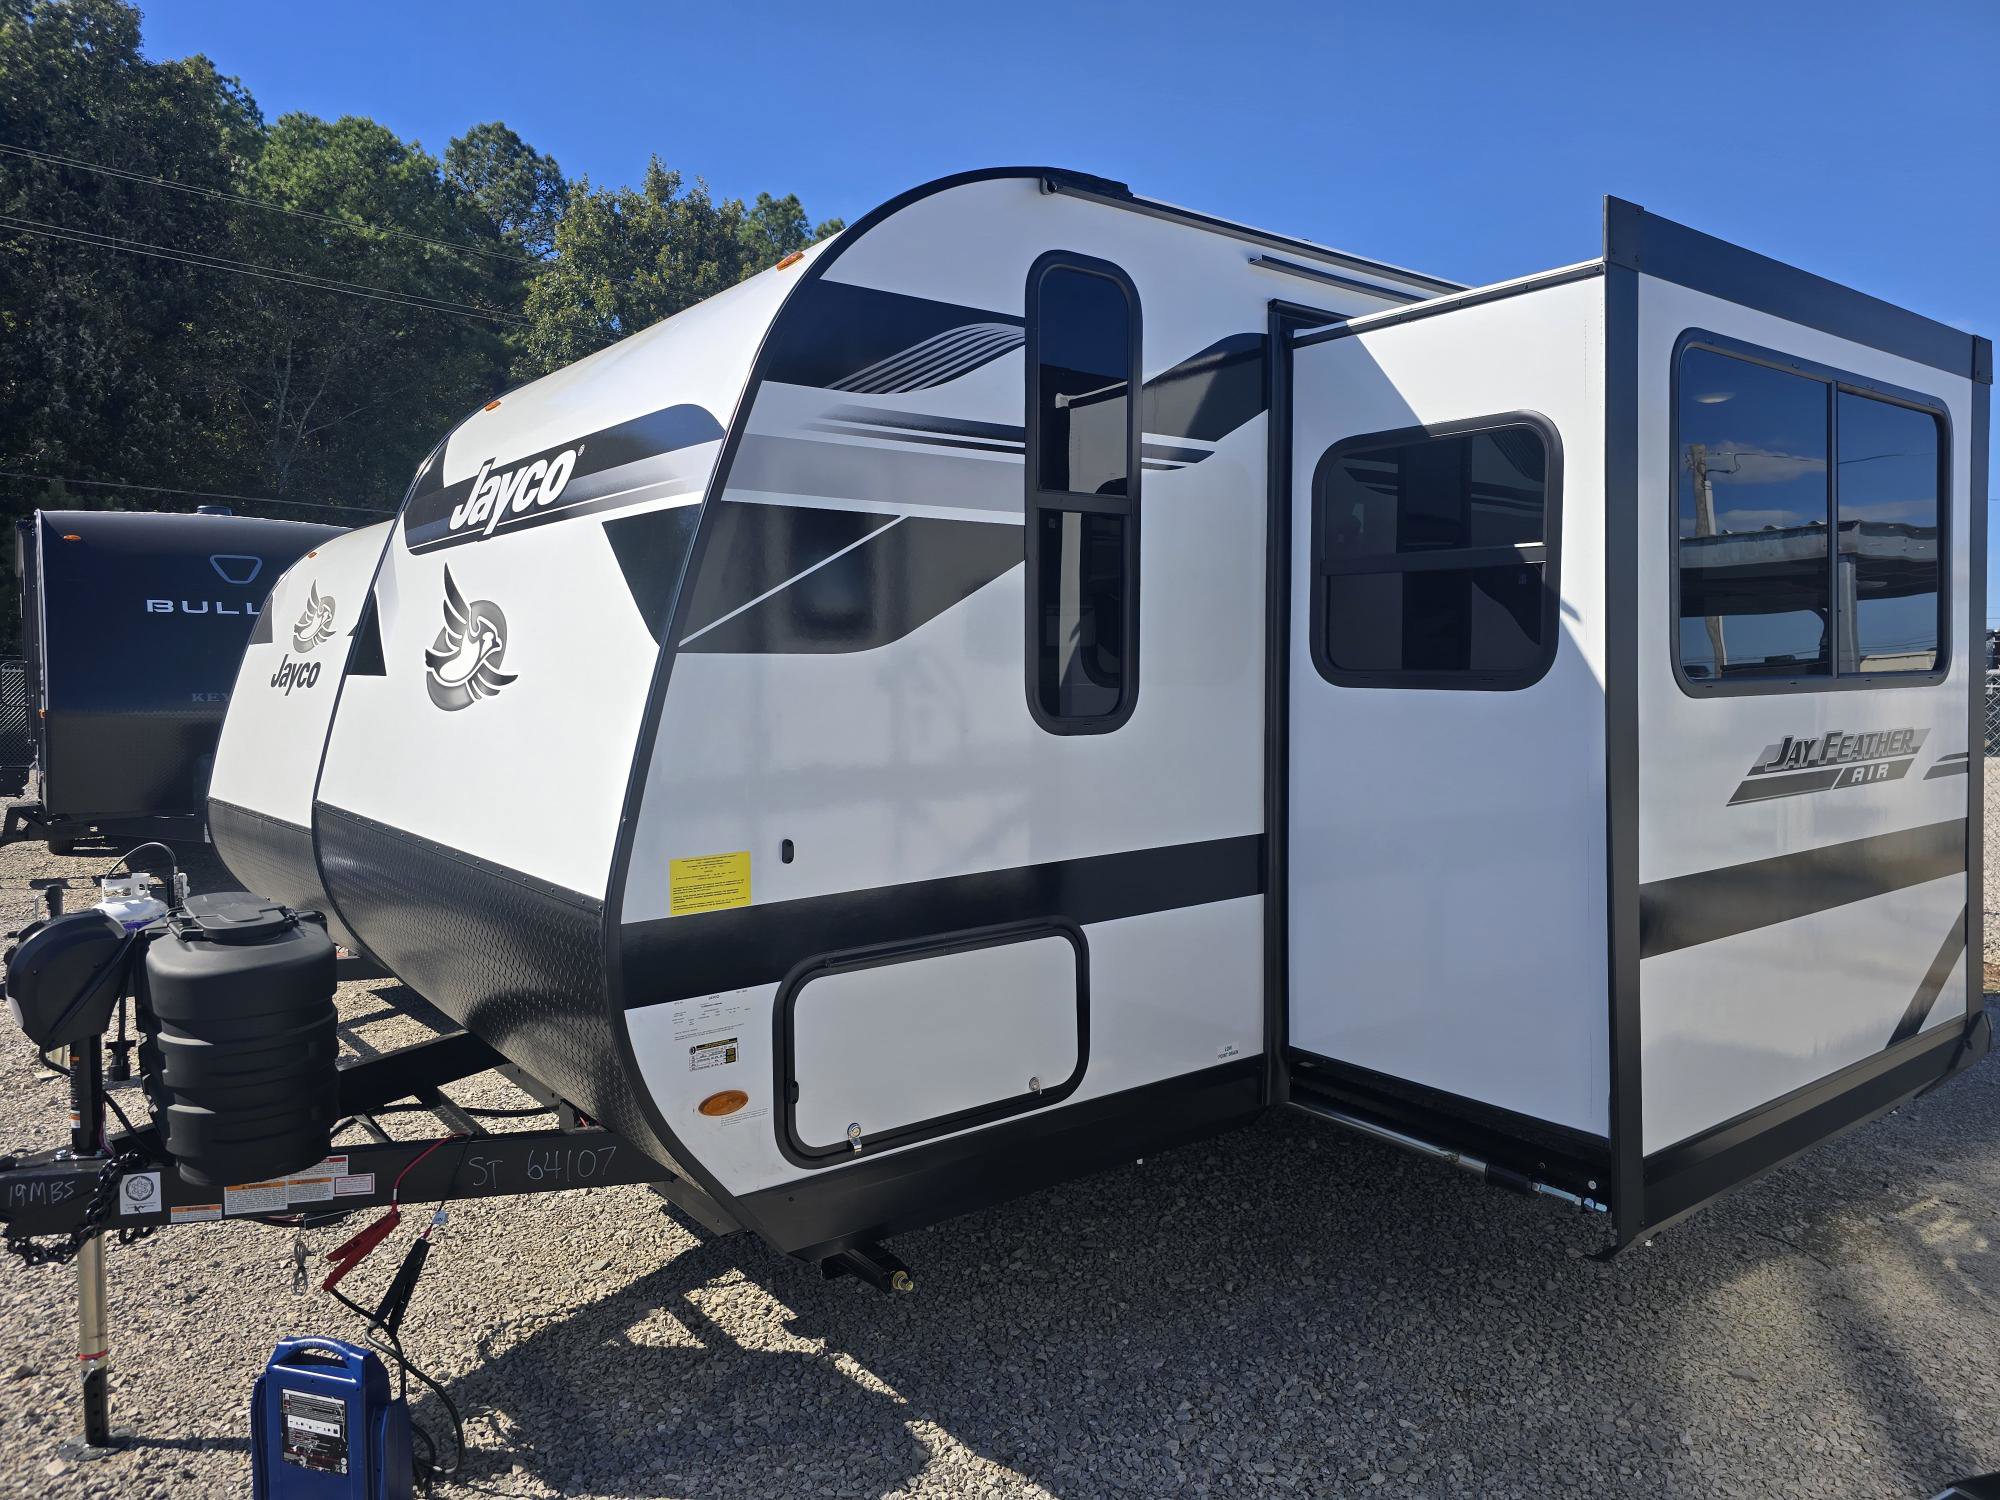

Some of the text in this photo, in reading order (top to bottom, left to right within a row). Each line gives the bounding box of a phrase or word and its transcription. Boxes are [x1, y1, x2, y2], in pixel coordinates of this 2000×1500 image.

[449, 449, 577, 536] Jayco
[270, 653, 322, 696] Jayco
[1765, 727, 1916, 772] JAY FEATHER
[1851, 764, 1889, 783] AIR
[469, 1146, 617, 1189] ST 64107
[9, 1180, 76, 1207] 19MBS
